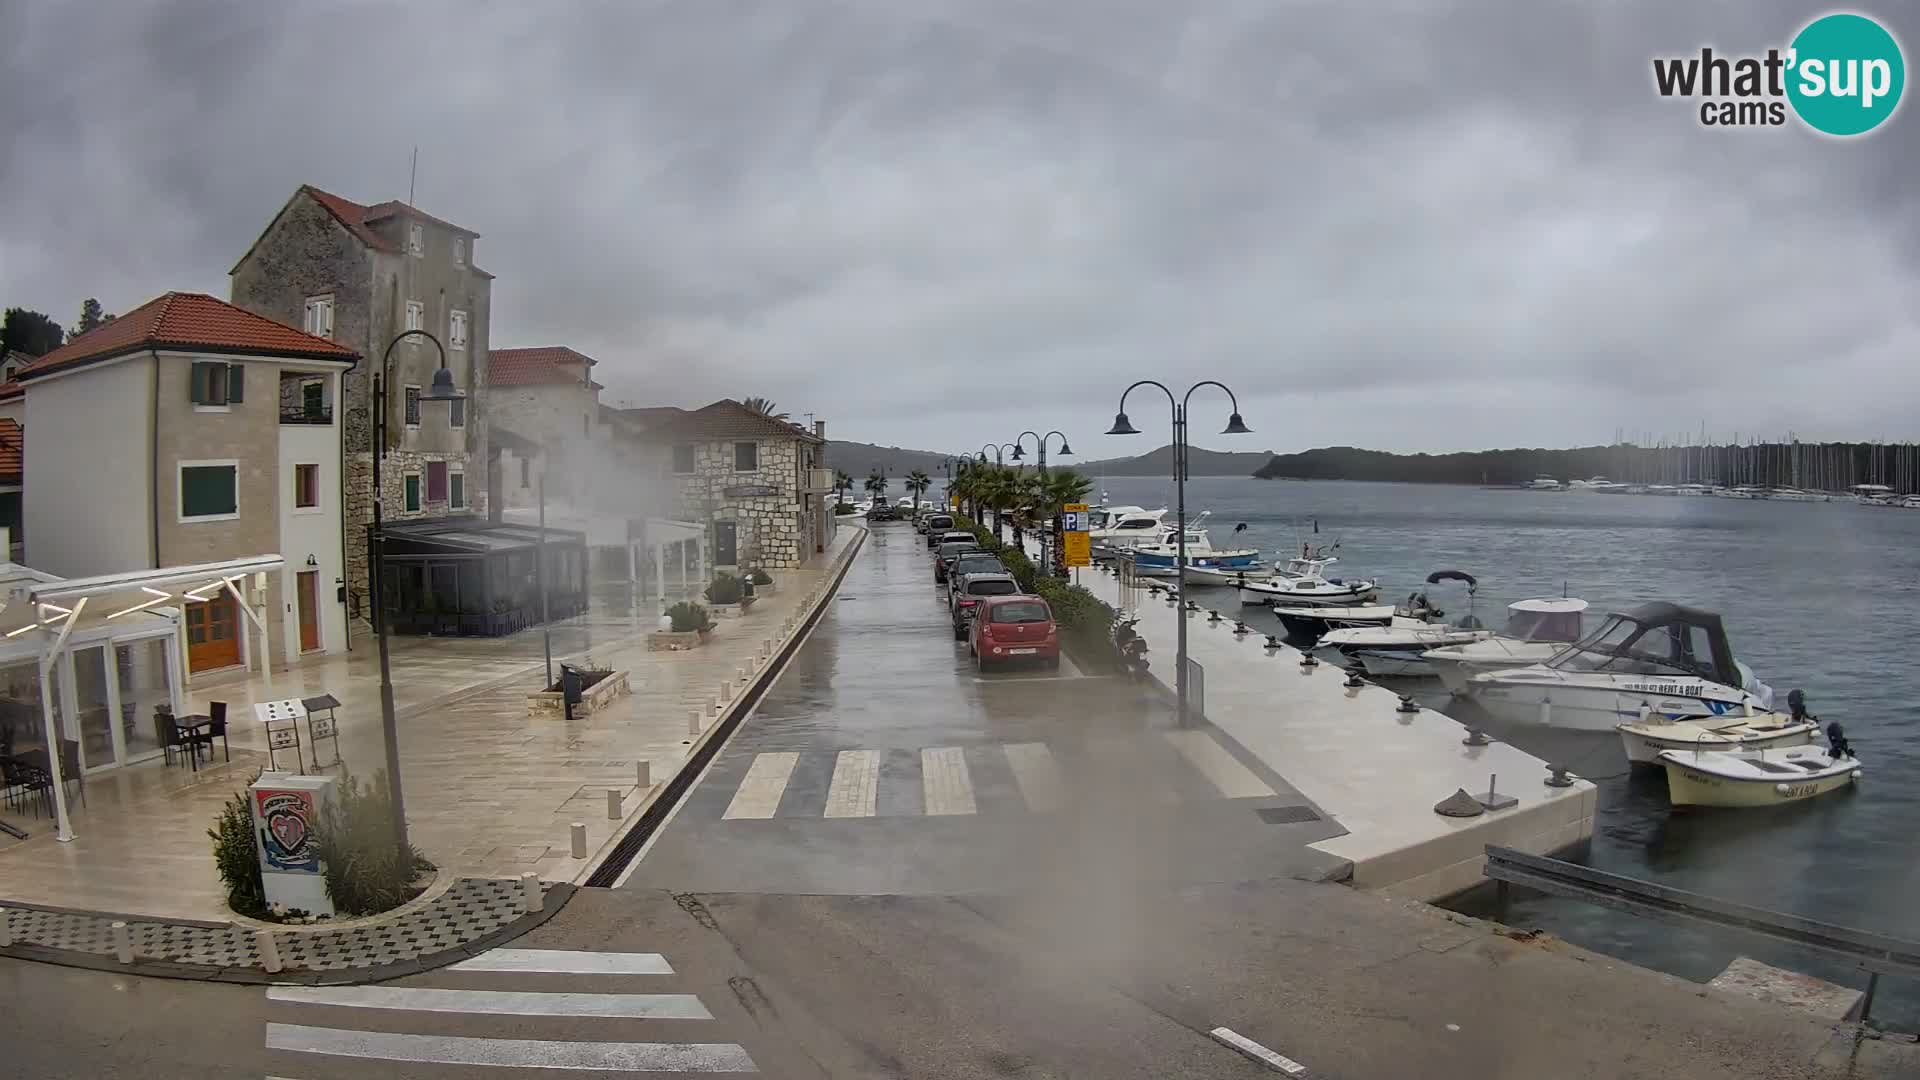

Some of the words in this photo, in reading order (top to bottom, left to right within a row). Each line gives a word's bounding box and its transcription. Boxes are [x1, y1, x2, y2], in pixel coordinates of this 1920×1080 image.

[1066, 513, 1077, 530] P
[1659, 685, 1678, 695] RENT
[1685, 686, 1704, 697] BOAT
